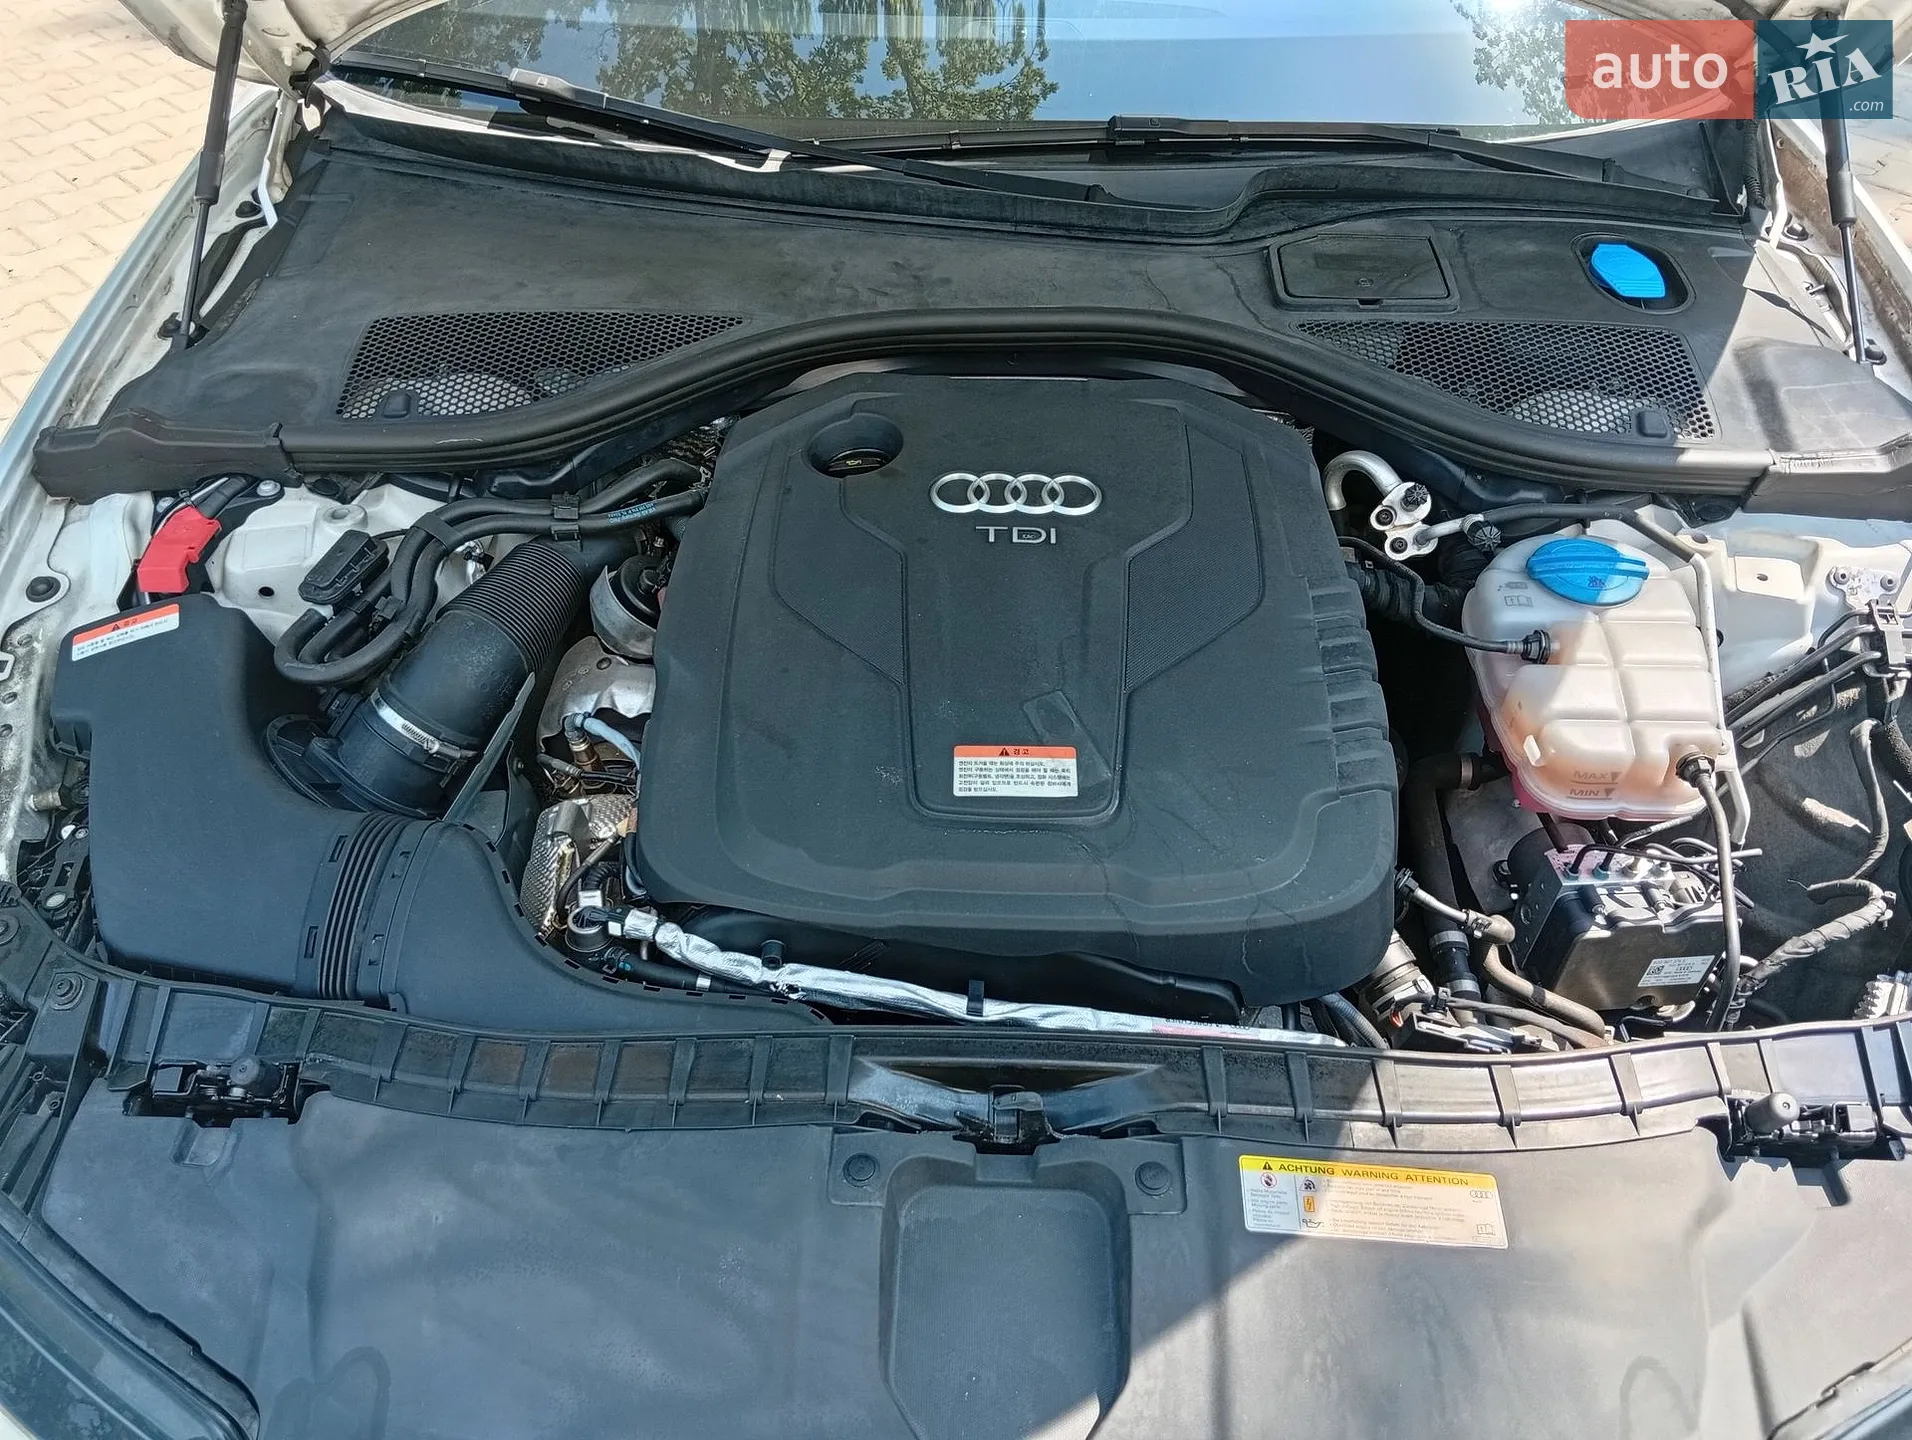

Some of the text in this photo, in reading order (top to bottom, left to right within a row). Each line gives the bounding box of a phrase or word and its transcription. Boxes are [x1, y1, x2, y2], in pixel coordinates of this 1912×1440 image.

[975, 526, 1057, 544] TDI
[1572, 770, 1609, 780] MAX
[1569, 788, 1600, 797] MIN
[1278, 1163, 1469, 1186] ACHTUNG WARNING ATTENTION
